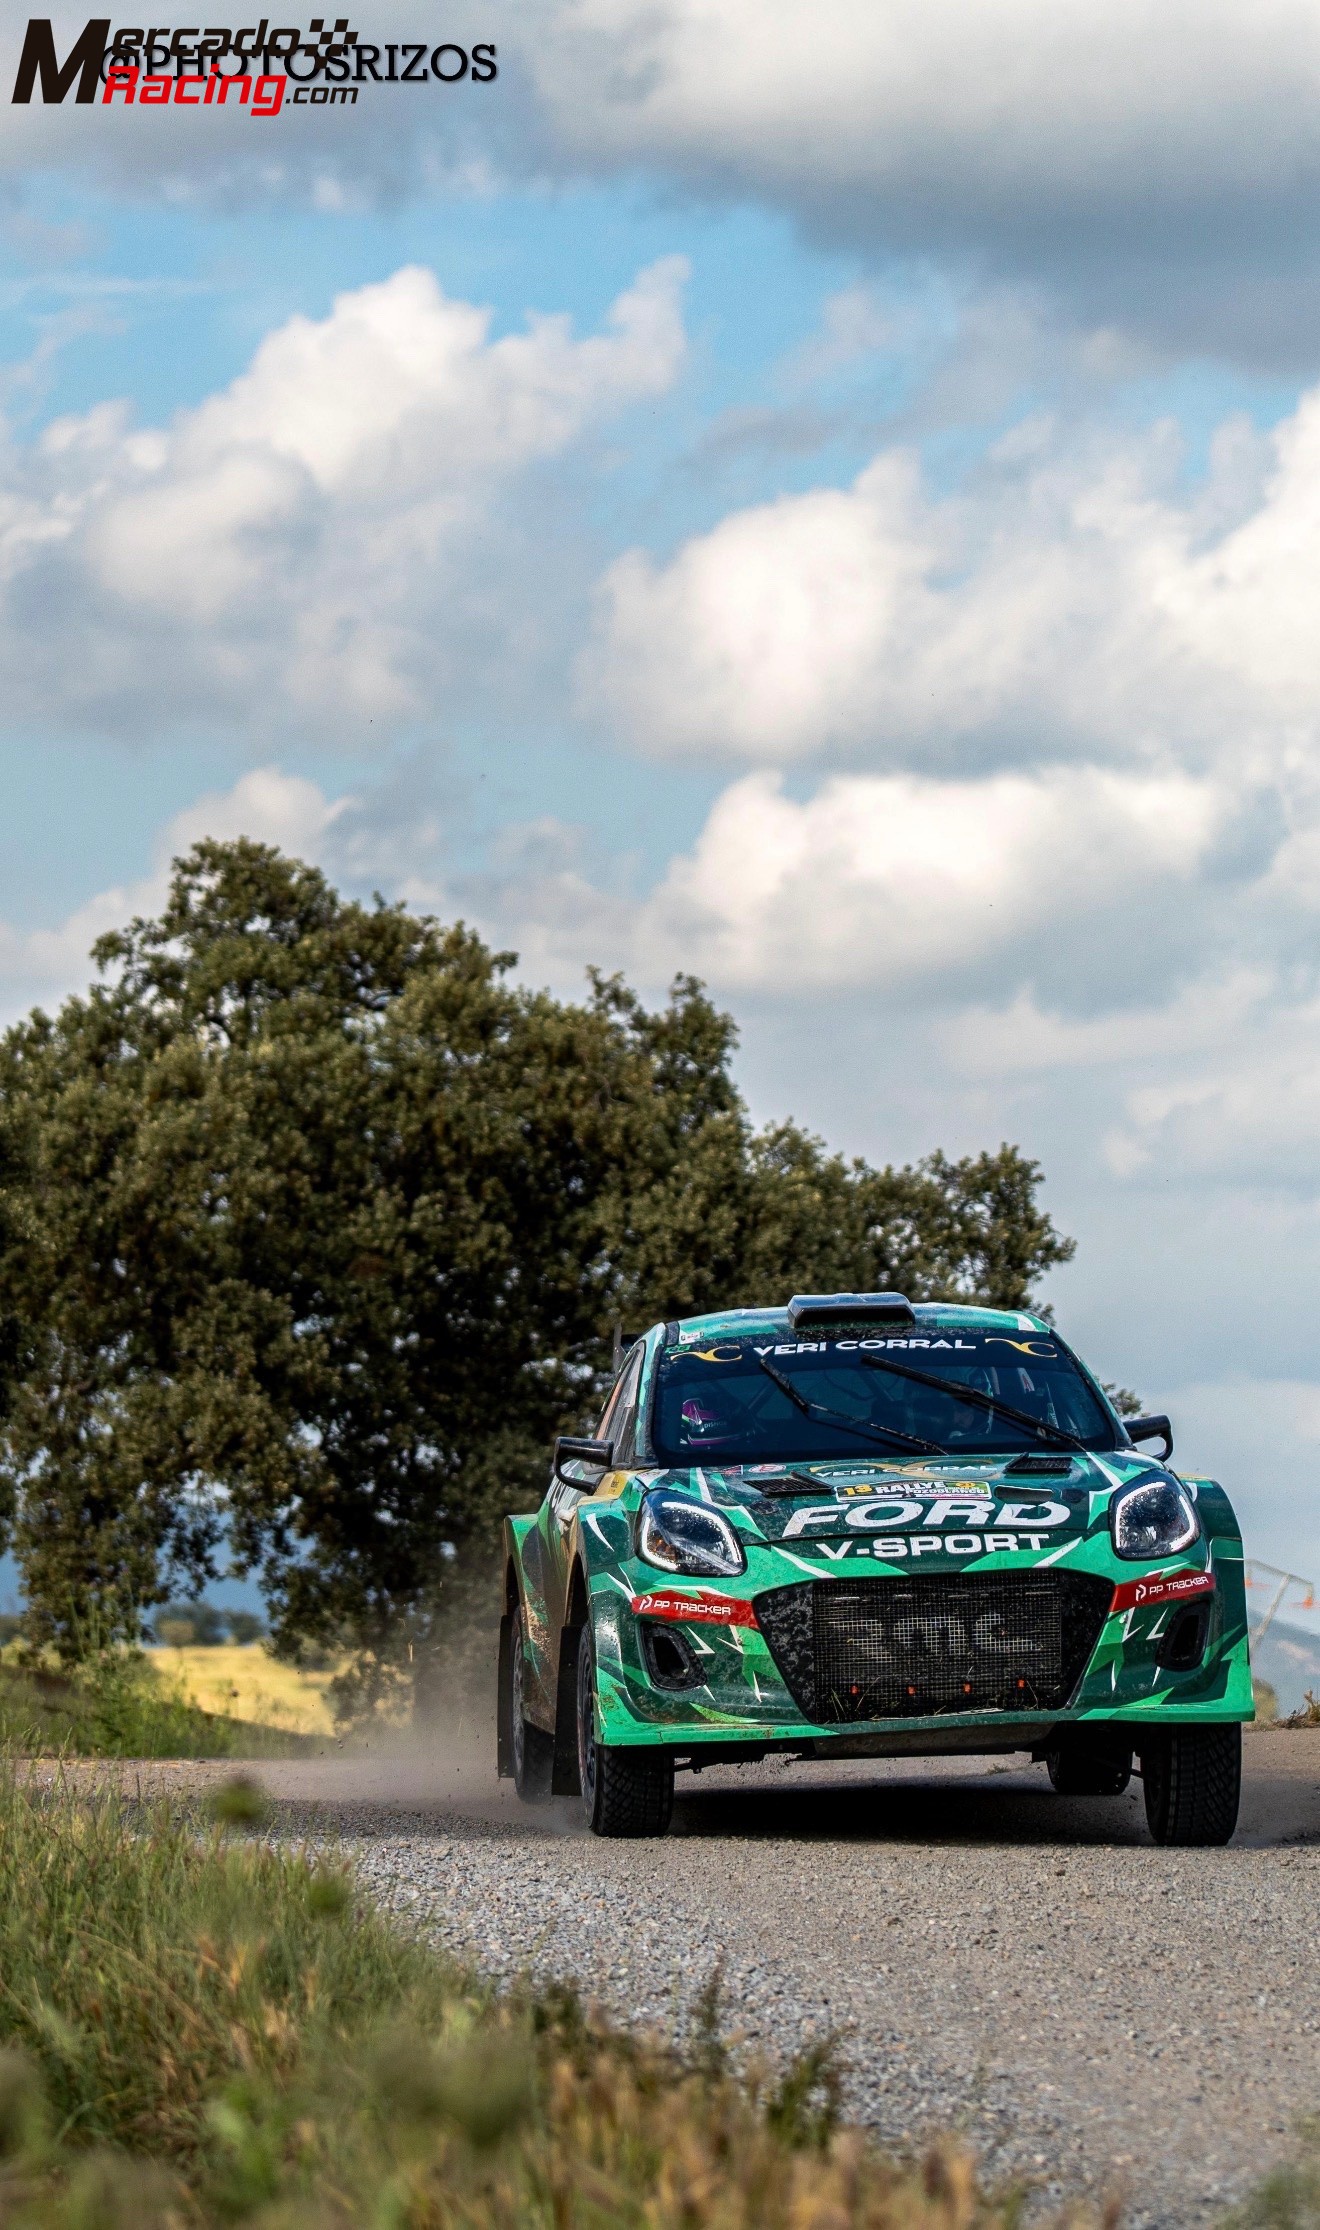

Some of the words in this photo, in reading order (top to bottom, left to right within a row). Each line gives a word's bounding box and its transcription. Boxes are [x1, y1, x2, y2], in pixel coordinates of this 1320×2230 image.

[835, 1339, 977, 1350] CORRAL
[875, 1481, 946, 1494] RALLYE
[781, 1500, 1071, 1538] FORD
[815, 1533, 1050, 1560] V-SPORT
[1149, 1585, 1164, 1595] PP
[653, 1600, 671, 1609] PP
[673, 1601, 732, 1616] TRACKER
